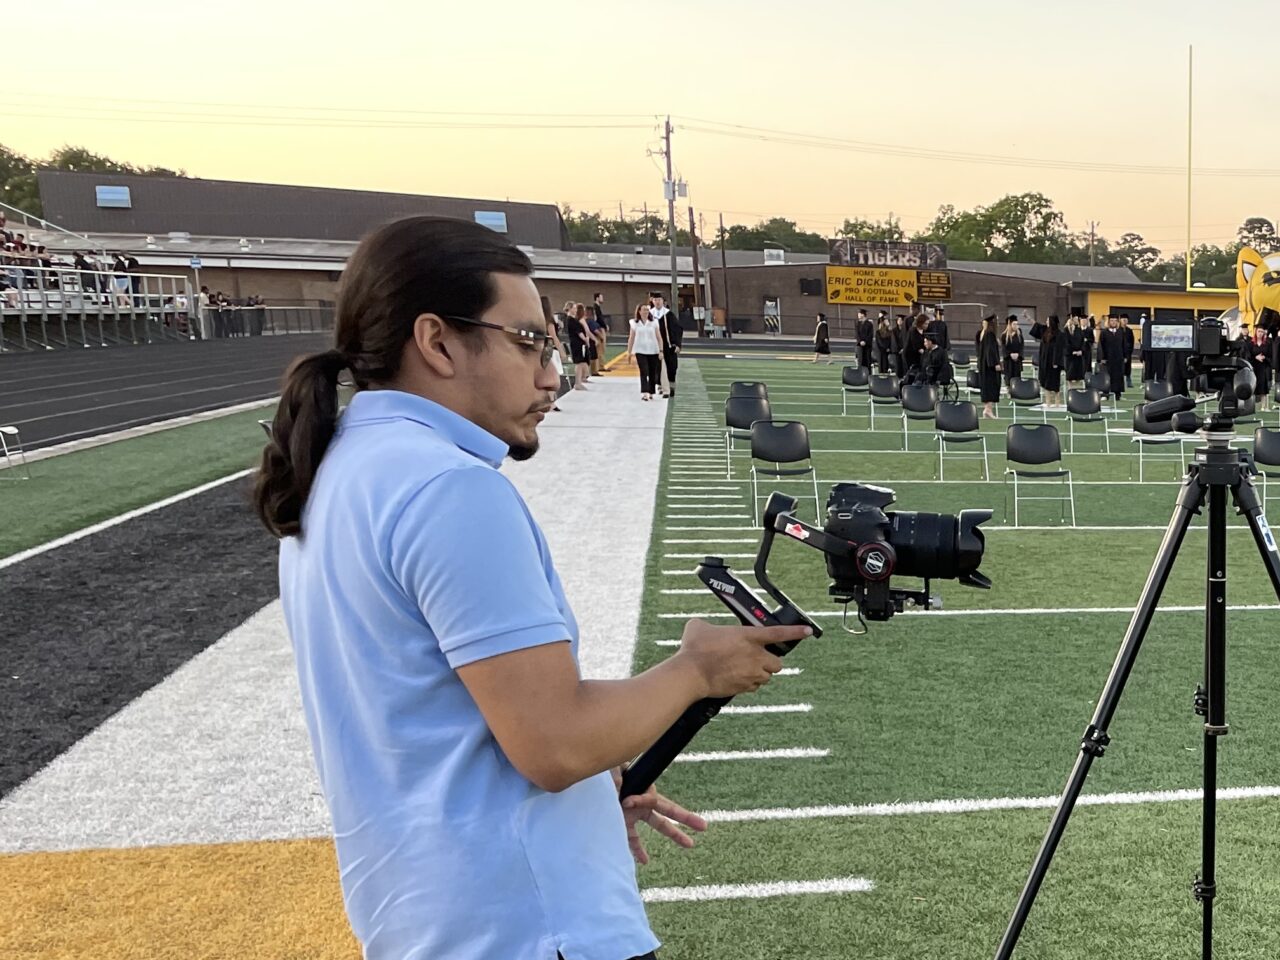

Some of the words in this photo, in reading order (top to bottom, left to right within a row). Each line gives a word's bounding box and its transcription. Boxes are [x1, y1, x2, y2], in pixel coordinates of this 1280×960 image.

[855, 249, 921, 266] TIGERS
[828, 277, 852, 286] ERIC
[857, 278, 915, 288] DICKERSON
